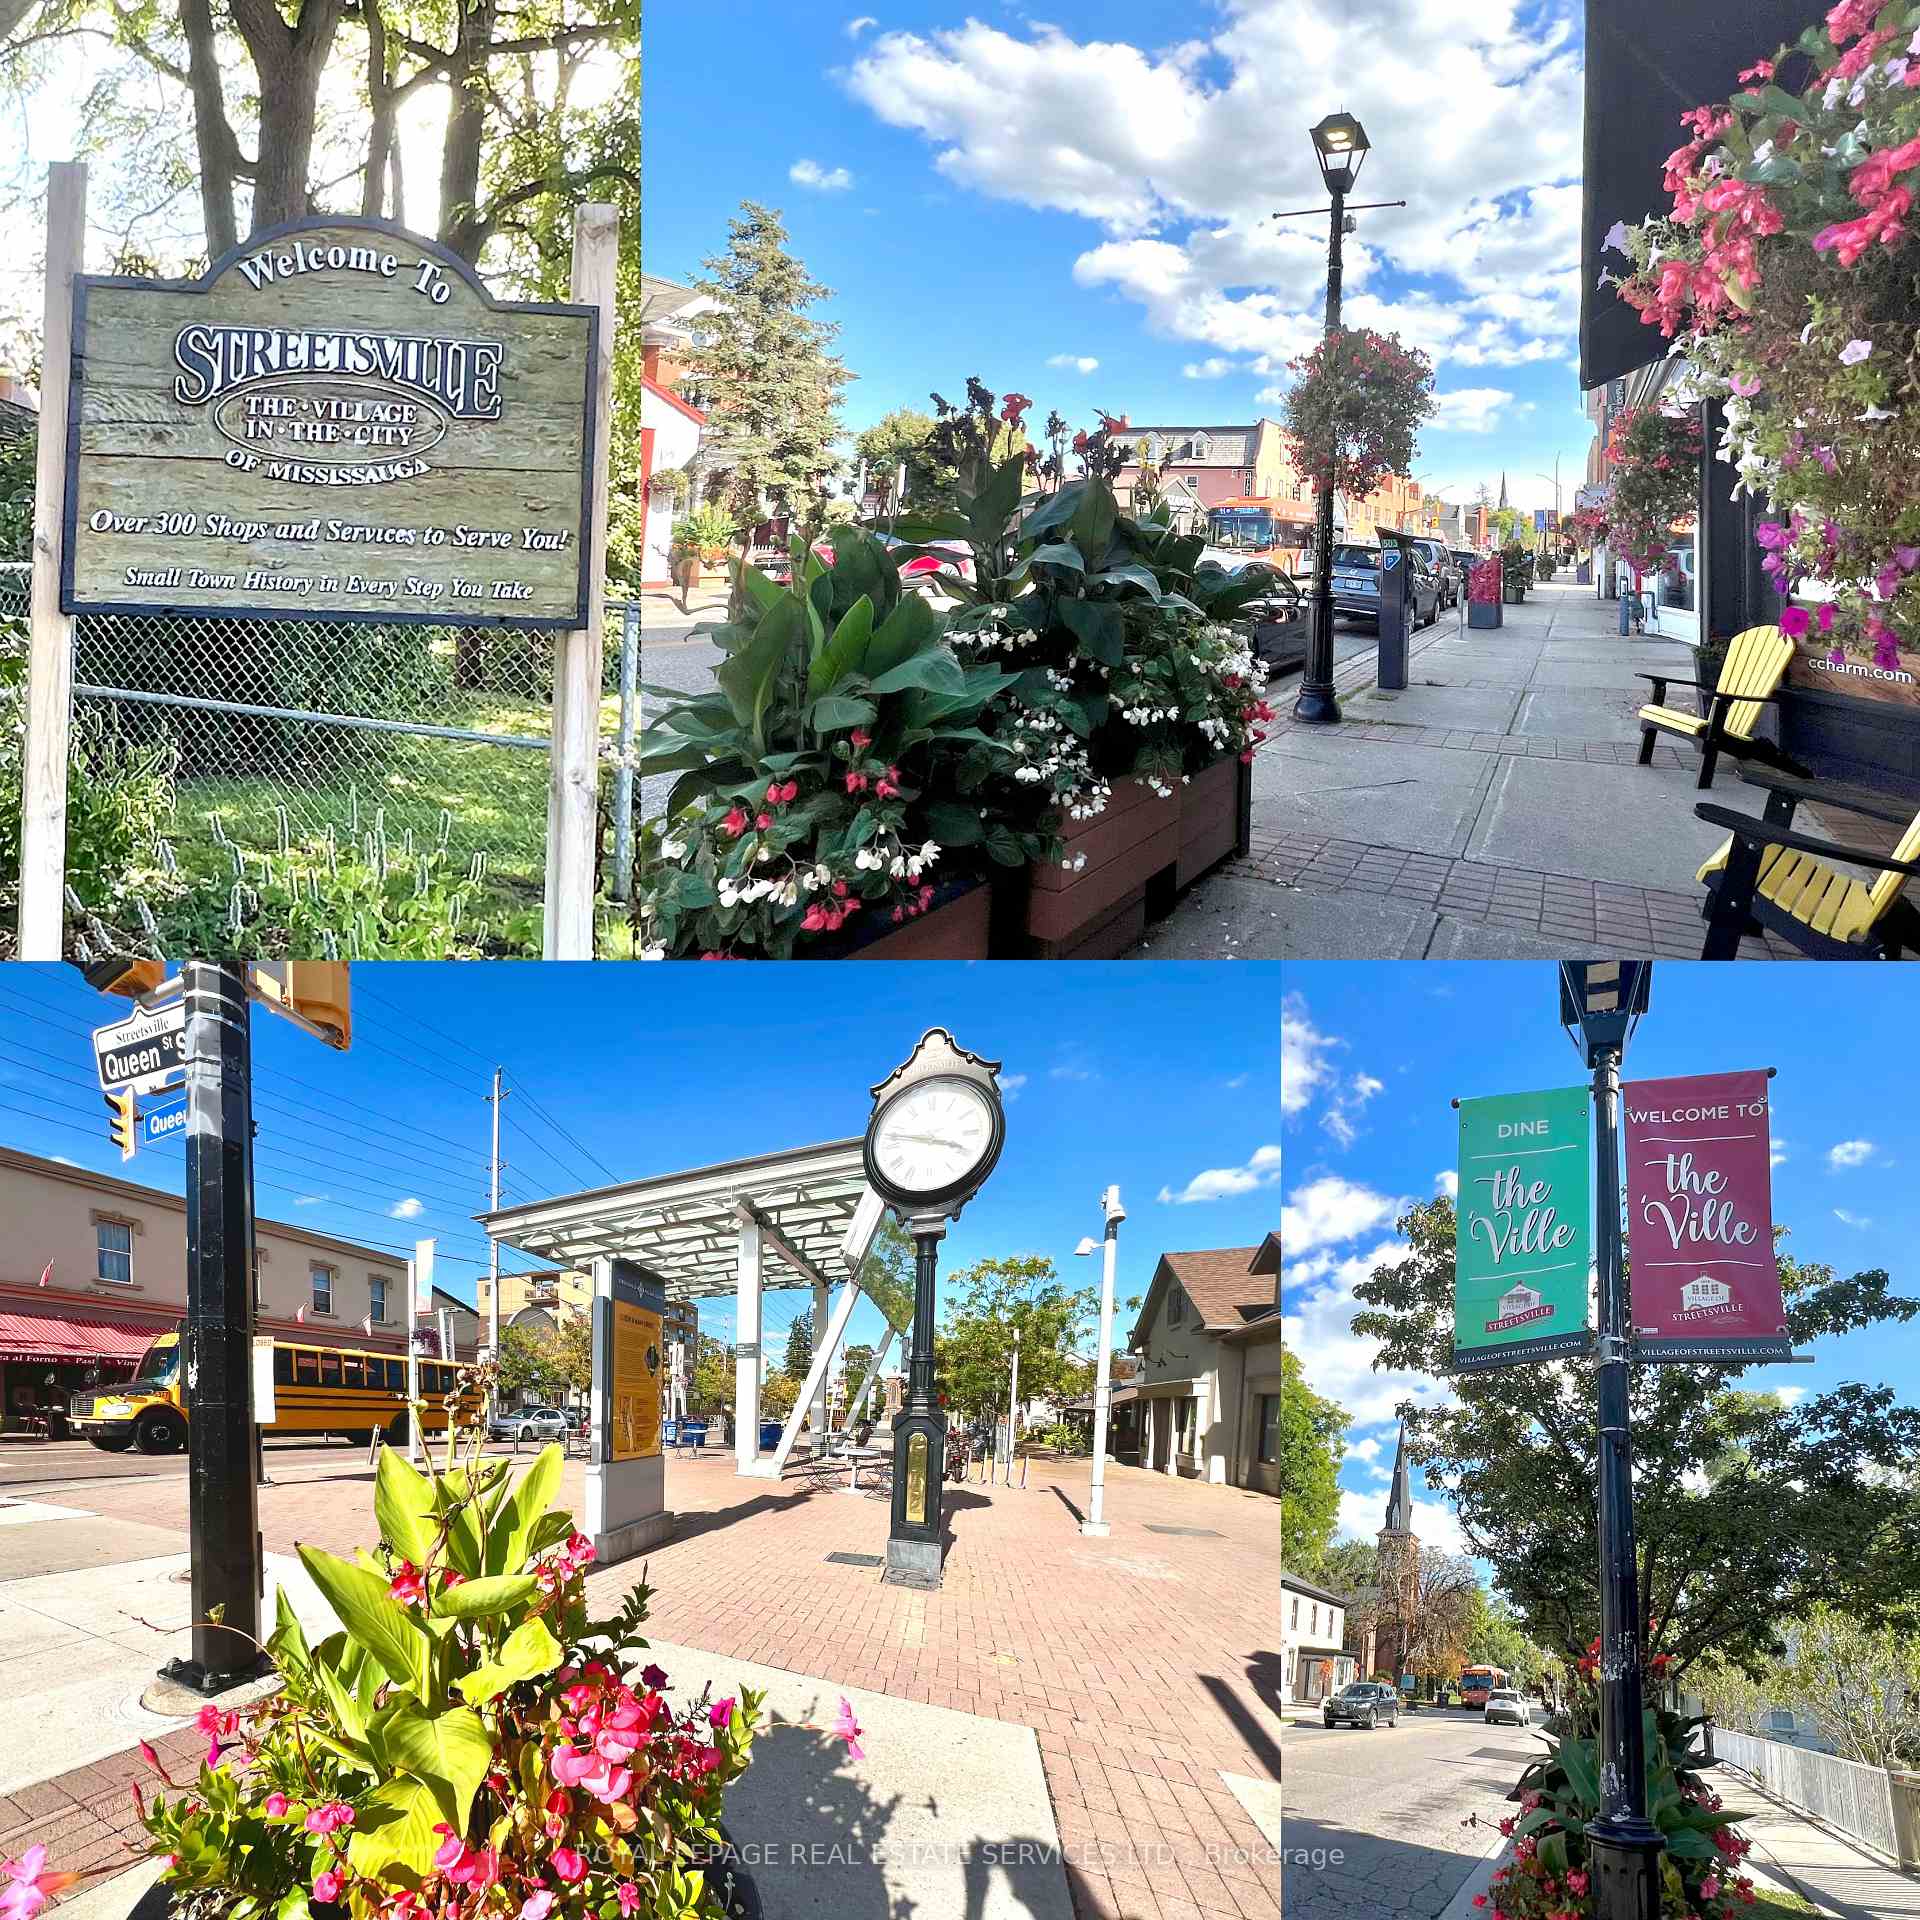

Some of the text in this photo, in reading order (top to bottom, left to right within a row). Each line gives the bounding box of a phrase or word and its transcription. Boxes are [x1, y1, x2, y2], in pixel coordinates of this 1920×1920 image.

[238, 242, 452, 304] Welcome To
[174, 323, 503, 420] STREETSVILLE
[245, 397, 417, 424] THE VILLAGE
[245, 420, 414, 446] IN THE CITY
[224, 450, 432, 485] OF MISSISSAUGA
[89, 509, 568, 550] Over 300 Shops and Services to Serve You!
[123, 567, 534, 600] Small Town History in Every Step You Take
[1808, 658, 1912, 683] ccharm.com
[115, 1018, 169, 1045] Streetsville
[105, 1047, 161, 1080] Queen
[162, 1036, 173, 1050] St
[150, 1111, 187, 1134] Quee
[1630, 1103, 1764, 1123] WELCOME TO
[1498, 1120, 1550, 1138] DINE
[1644, 1152, 1728, 1195] the
[1474, 1166, 1552, 1210] the
[1488, 1307, 1551, 1330] STREETSVILLE
[1672, 1304, 1743, 1321] STREETSVILLE
[25, 1355, 58, 1363] Forno
[1459, 1340, 1581, 1364] VILLAGEOFSTREETSVILLE.COM
[1641, 1347, 1784, 1356] VILLAGEOFSTREETSVILLE.COM
